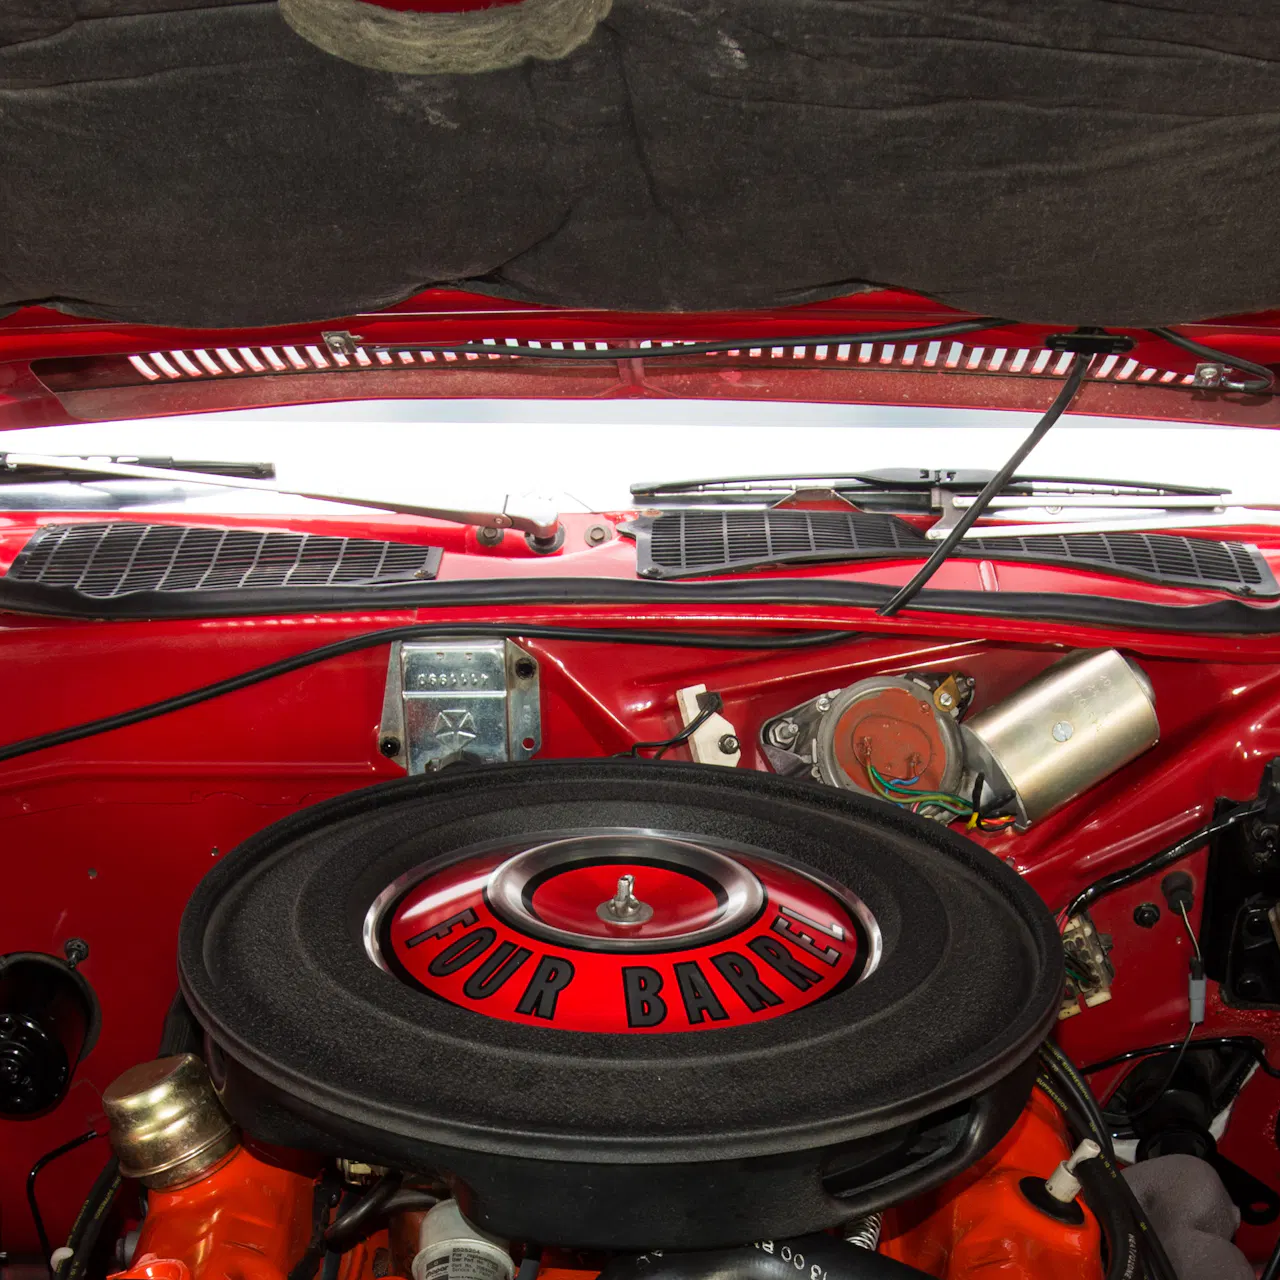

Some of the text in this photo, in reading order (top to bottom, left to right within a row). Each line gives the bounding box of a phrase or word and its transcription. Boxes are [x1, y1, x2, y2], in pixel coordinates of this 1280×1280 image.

[405, 905, 845, 1028] FOUR BARREL
[1036, 1076, 1069, 1112] SUPPRESSION
